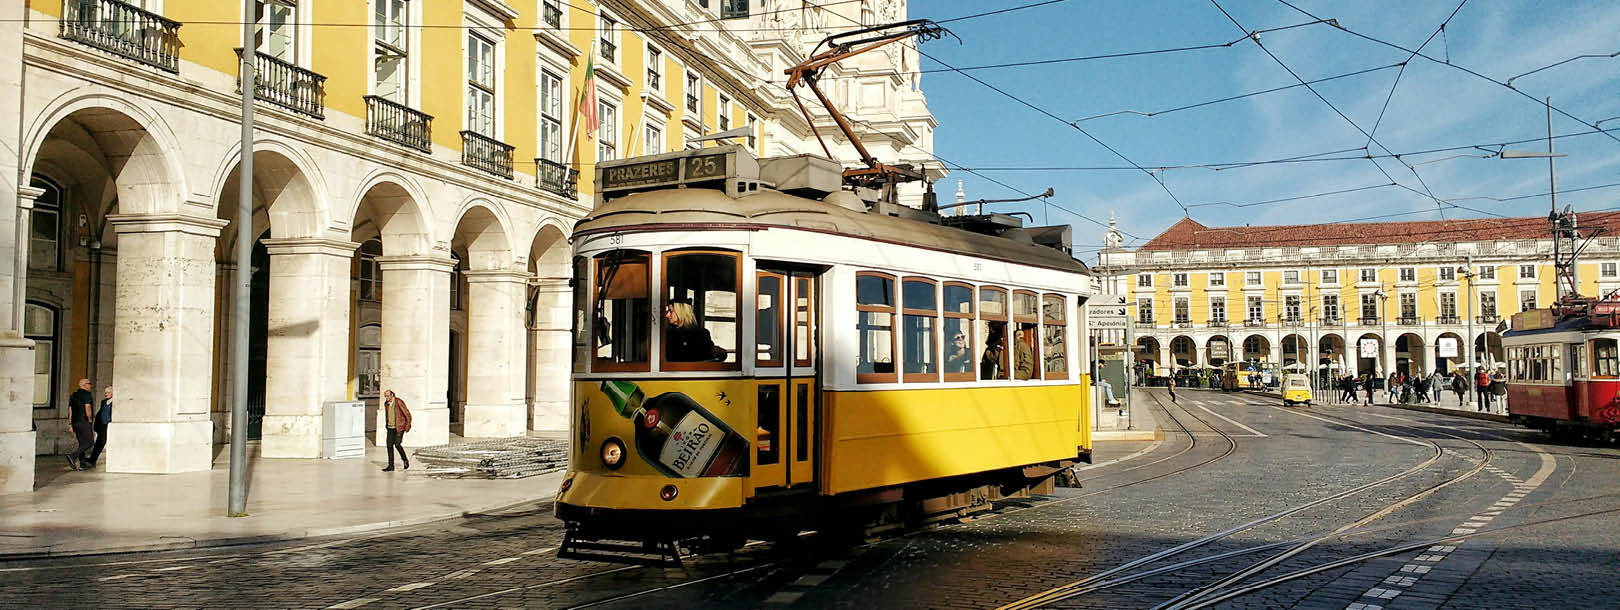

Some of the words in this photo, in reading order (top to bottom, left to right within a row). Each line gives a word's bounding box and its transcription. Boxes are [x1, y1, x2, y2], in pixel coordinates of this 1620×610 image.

[609, 163, 674, 181] PRAZERES
[692, 157, 717, 177] 25
[610, 235, 624, 245] 581
[672, 423, 709, 471] BEIRÃO
